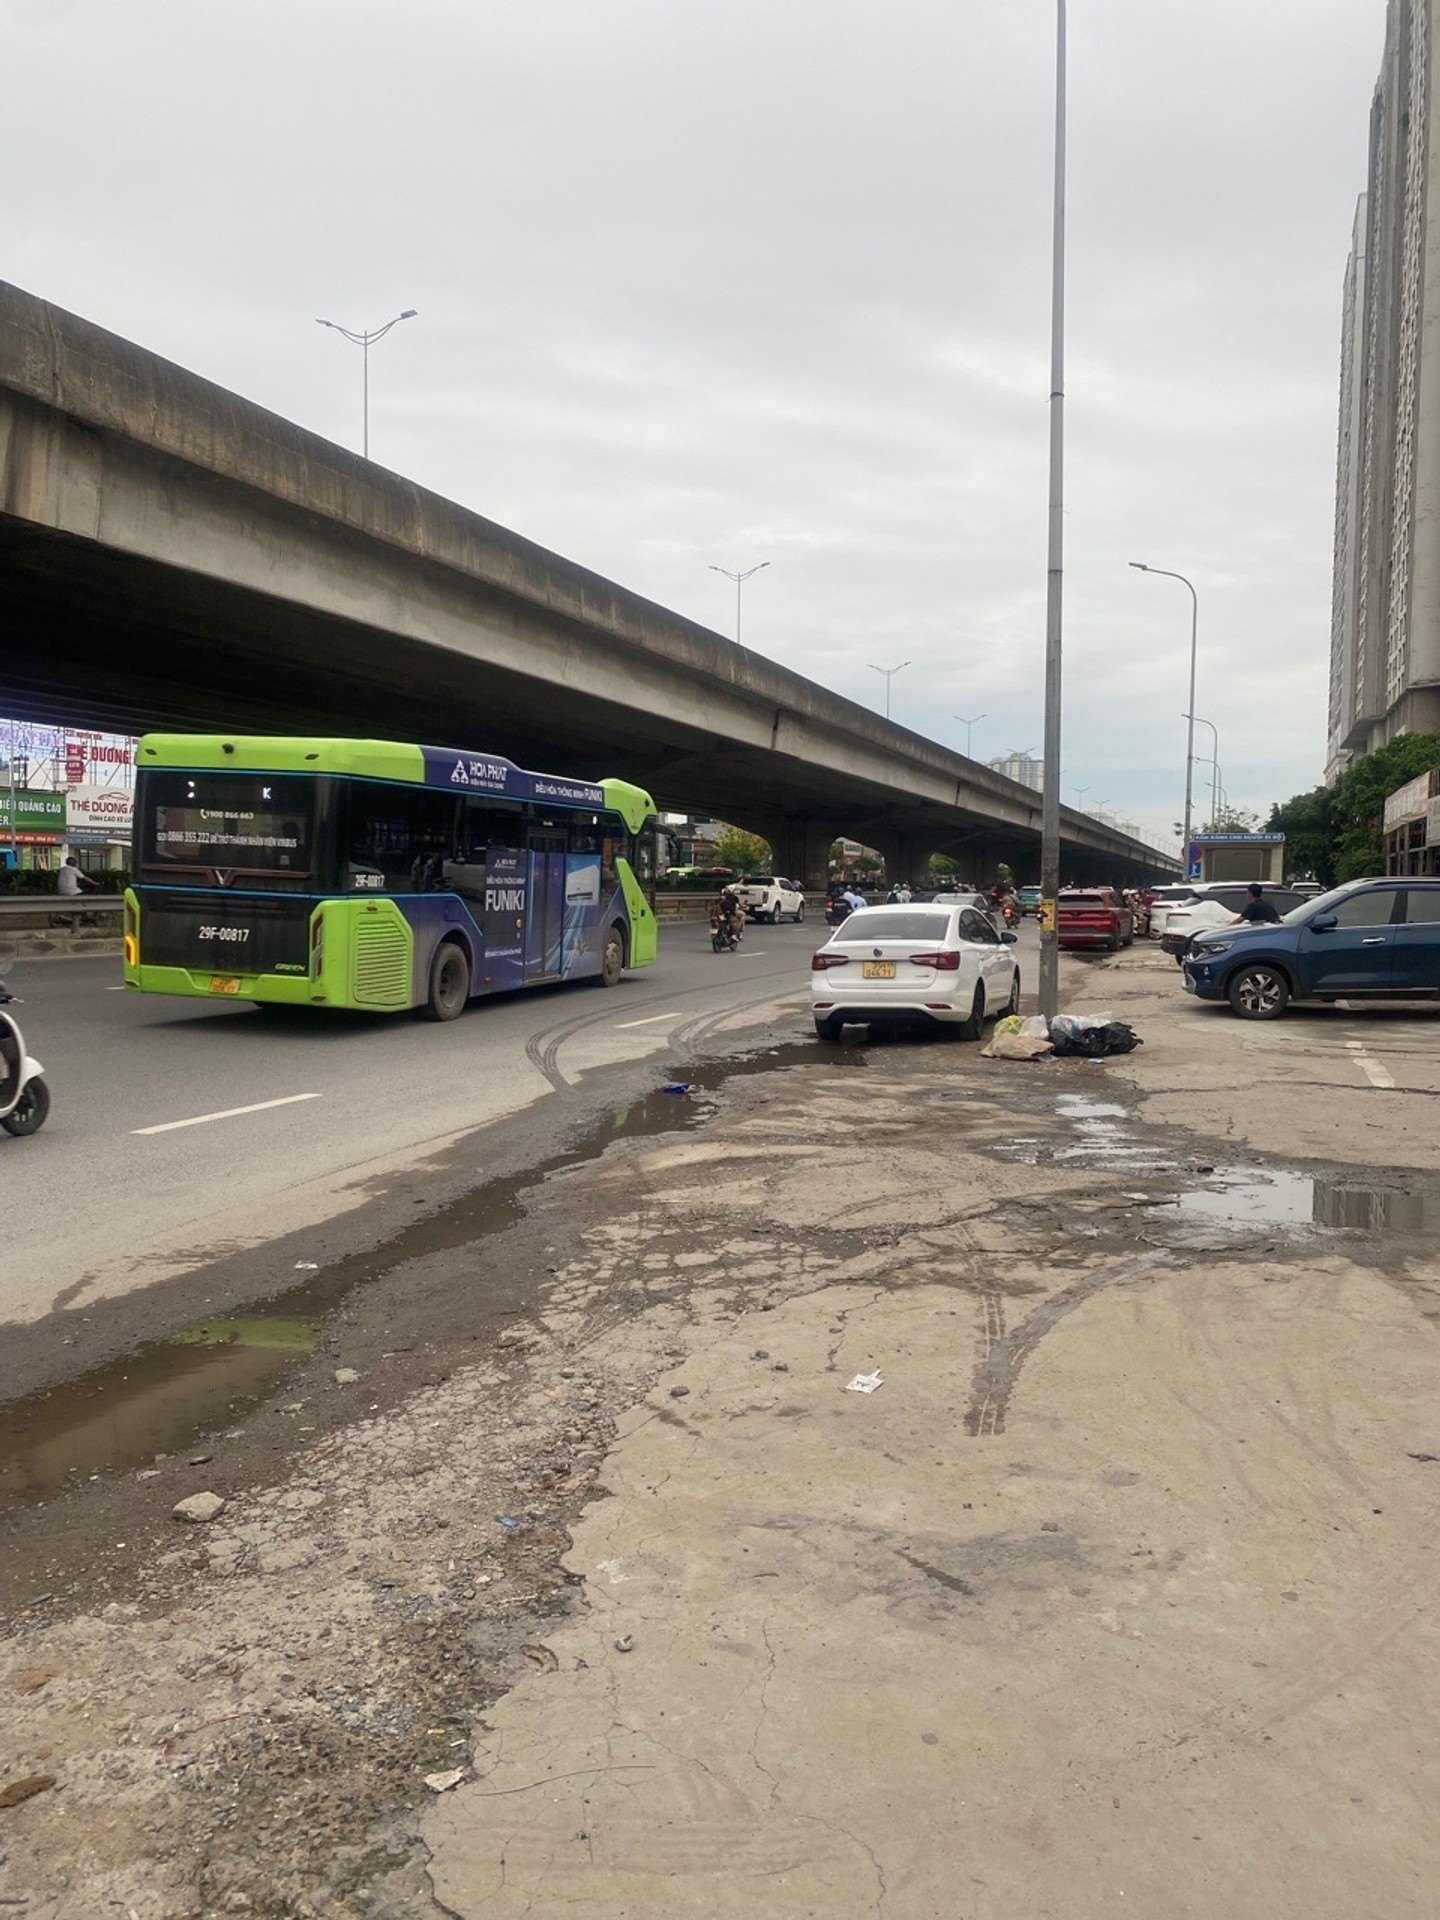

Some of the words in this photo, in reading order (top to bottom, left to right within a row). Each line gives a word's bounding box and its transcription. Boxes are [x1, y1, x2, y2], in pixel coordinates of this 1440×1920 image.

[584, 787, 602, 802] FUNIKI
[197, 832, 210, 843] 222
[485, 889, 524, 911] FUNIKI
[198, 926, 250, 942] 29F-00817
[274, 962, 306, 972] GREEN
